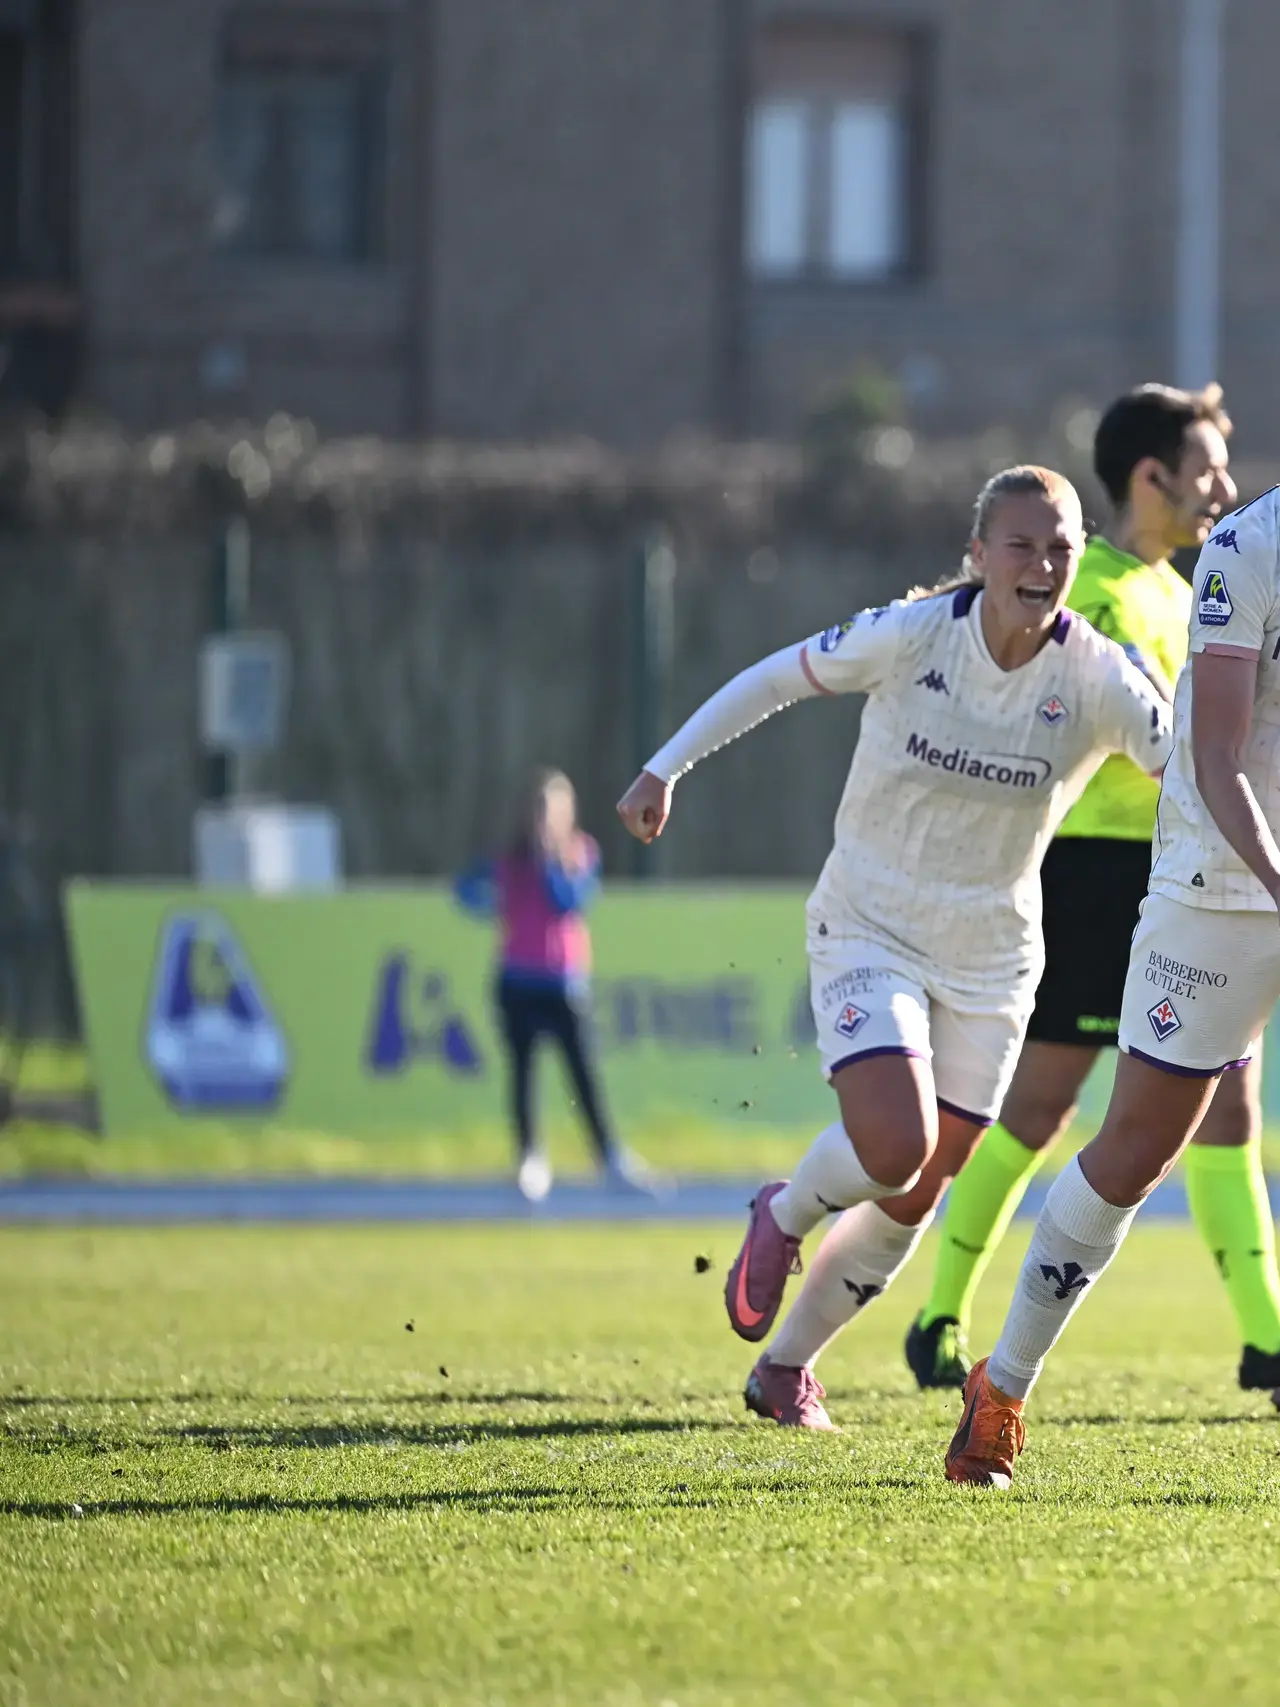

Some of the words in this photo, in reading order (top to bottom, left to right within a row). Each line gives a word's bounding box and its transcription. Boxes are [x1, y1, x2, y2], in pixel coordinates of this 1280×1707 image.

[905, 732, 1038, 788] Mediacom
[1145, 967, 1197, 1000] OUTLET.
[1148, 950, 1228, 988] BARBERINO
